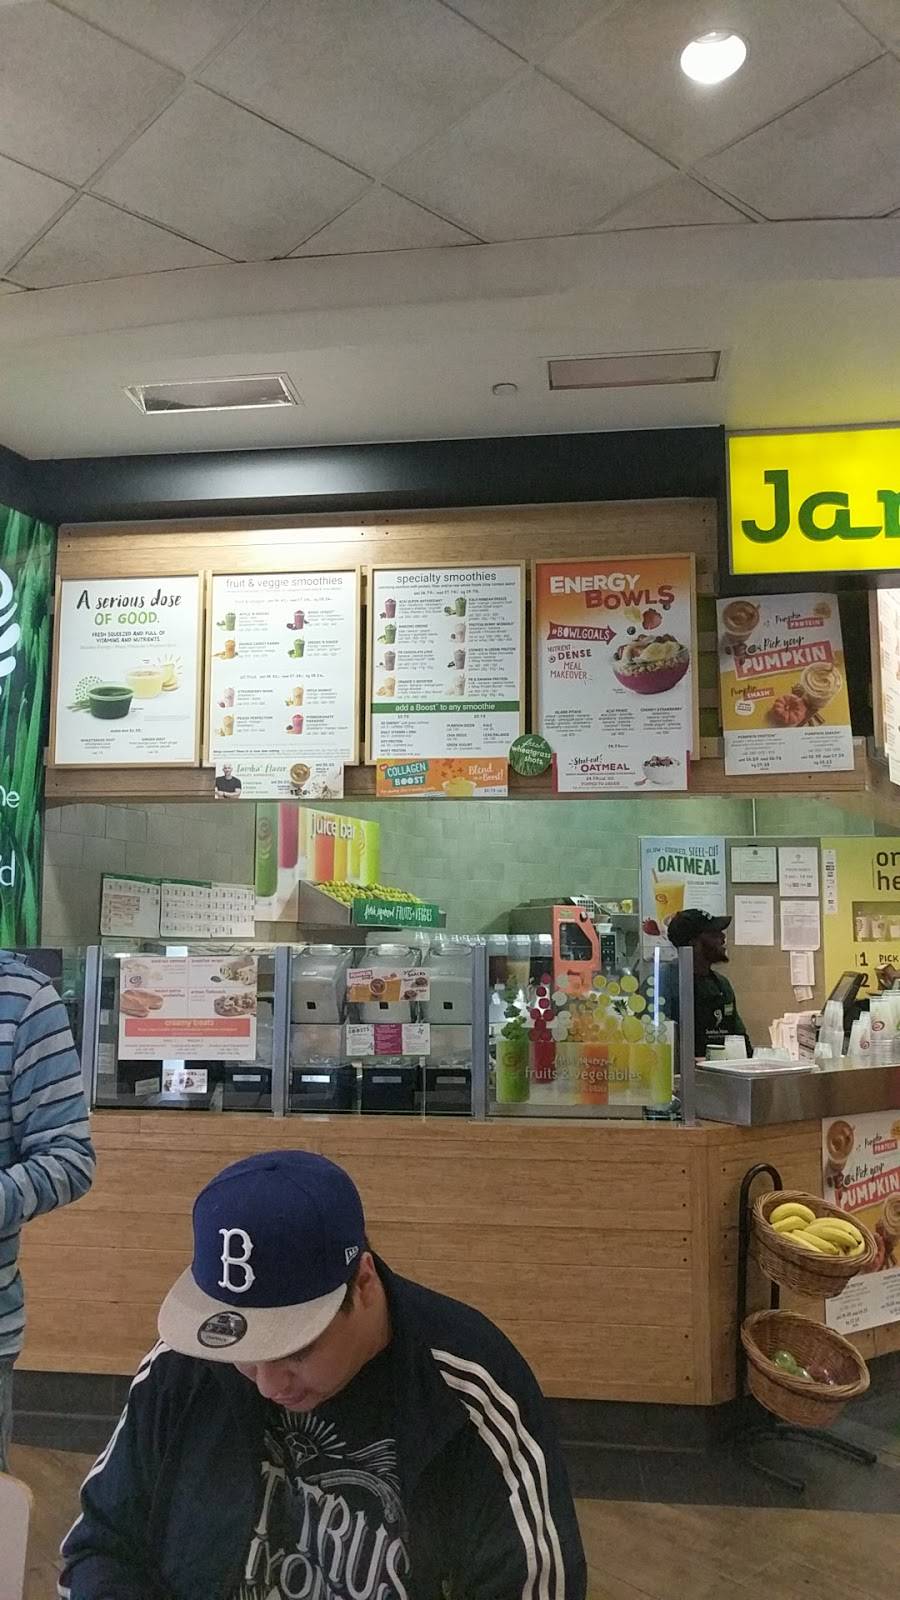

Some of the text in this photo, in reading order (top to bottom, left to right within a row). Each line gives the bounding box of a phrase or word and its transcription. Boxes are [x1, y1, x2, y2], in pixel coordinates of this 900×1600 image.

[226, 576, 344, 589] fruit & veggie smoothies
[396, 575, 436, 587] specialty
[443, 572, 497, 583] smoothies
[550, 573, 641, 595] ENERGY
[76, 588, 182, 610] A serious dose
[585, 585, 675, 610] BOWLS
[95, 611, 160, 626] OF GOOD.
[551, 627, 611, 641] #BOWLGOALS
[547, 644, 571, 652] NUTRIENT
[764, 636, 804, 652] Pick your
[558, 649, 592, 661] DENSE
[742, 645, 827, 674] PUMPKIN
[563, 662, 582, 671] MEAL
[550, 670, 588, 680] MAKEOVER
[747, 690, 770, 699] SMASH
[448, 705, 461, 713] any
[462, 703, 496, 711] smoothie
[511, 745, 551, 759] wheatgrass
[524, 754, 543, 765] shots
[387, 763, 426, 778] COLLAGEN
[468, 763, 493, 776] Blend
[580, 763, 630, 773] OATMEAL
[394, 776, 425, 786] BOOST
[310, 814, 356, 840] juice bar
[658, 855, 720, 875] OATMEAL
[859, 952, 899, 966] 1 PICK
[525, 1067, 642, 1084] fruits & vegetables
[841, 1172, 900, 1210] PUMPKIN
[218, 1227, 256, 1294] B
